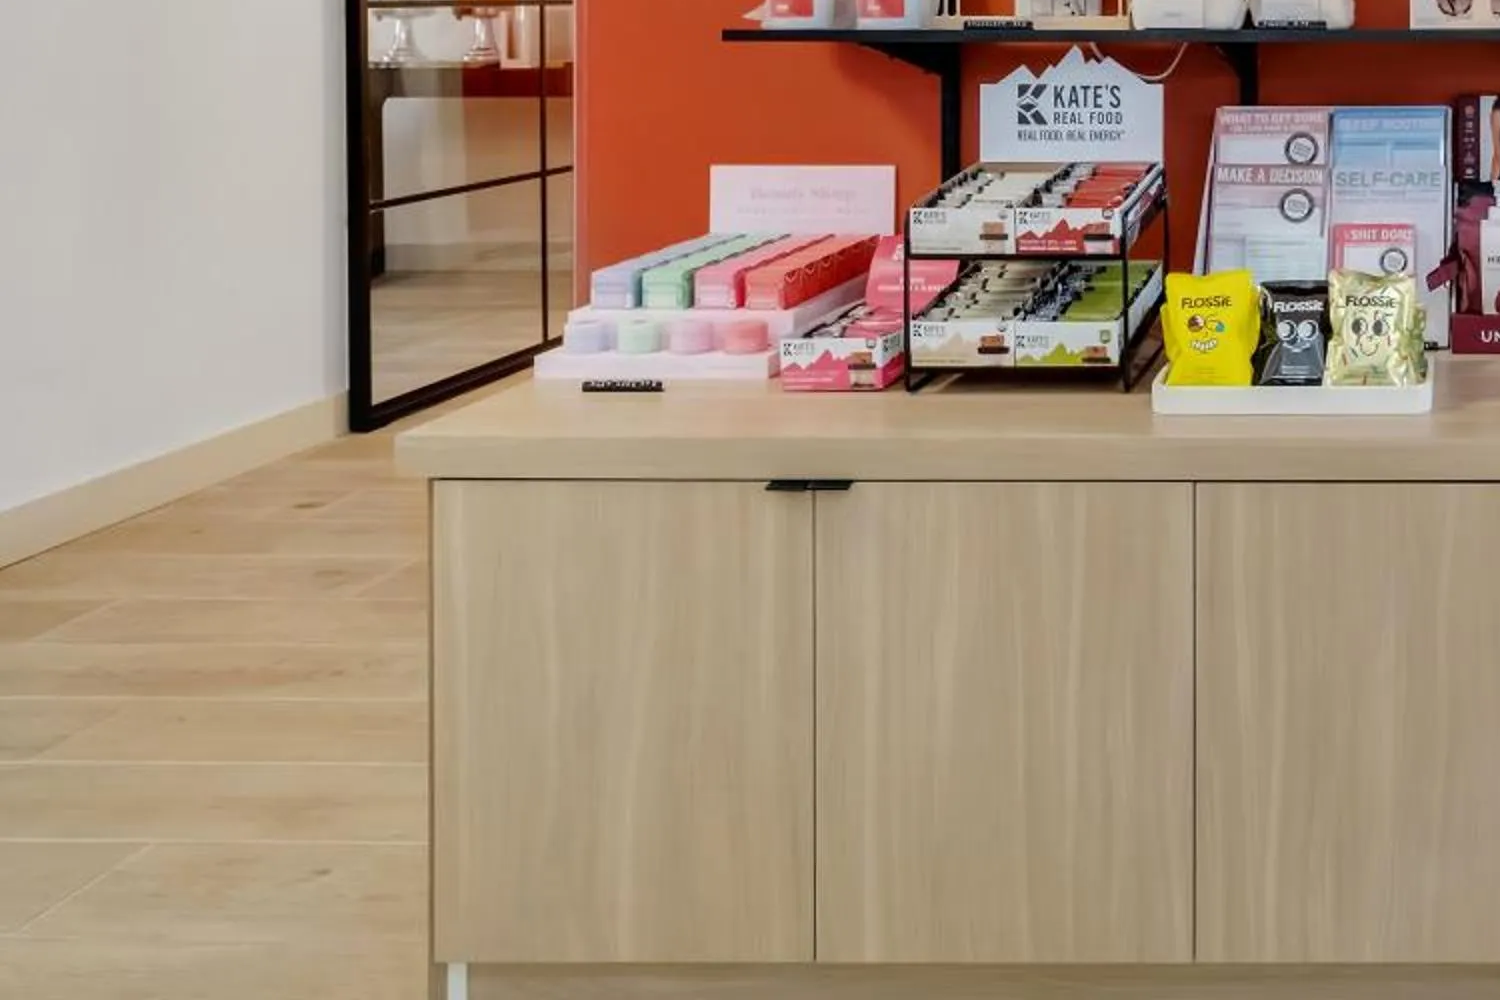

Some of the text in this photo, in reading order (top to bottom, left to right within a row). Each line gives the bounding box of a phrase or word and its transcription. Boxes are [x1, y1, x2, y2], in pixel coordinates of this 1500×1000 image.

[1053, 84, 1122, 109] KATE'S
[1053, 111, 1123, 125] REAL FOOD
[1217, 167, 1323, 184] MAKE A DECISION
[1335, 171, 1441, 188] SELF-CARE
